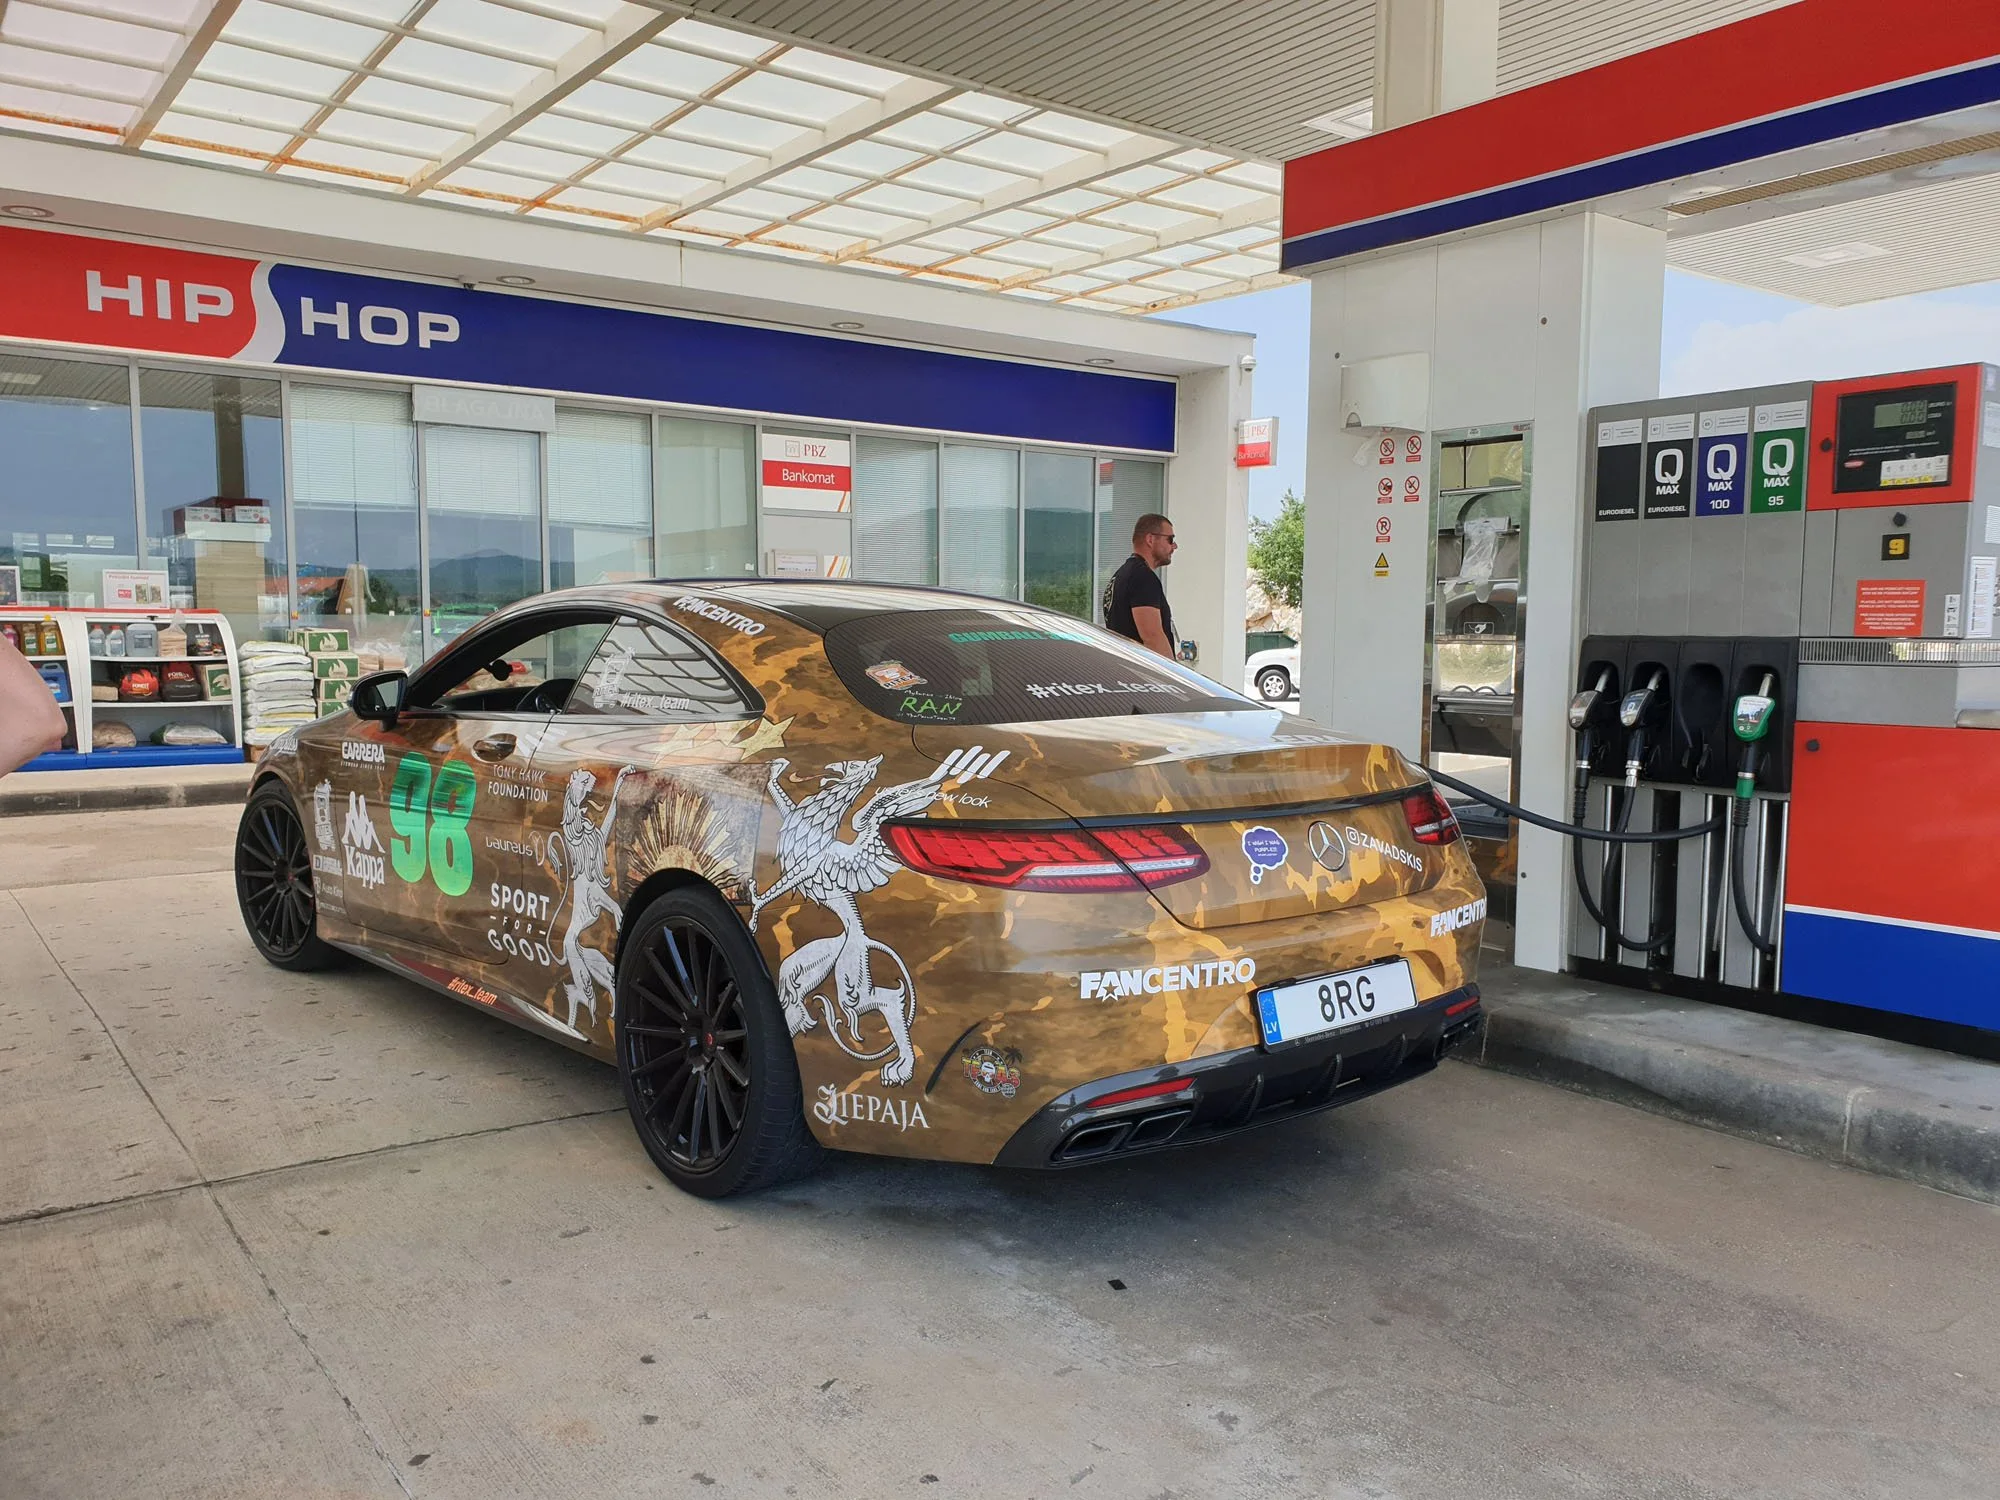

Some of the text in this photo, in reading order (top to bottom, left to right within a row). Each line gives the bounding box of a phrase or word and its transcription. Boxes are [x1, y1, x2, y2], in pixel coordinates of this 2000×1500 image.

[86, 270, 460, 349] HIP HOP
[804, 444, 827, 458] PBZ
[1762, 438, 1794, 477] Q
[1655, 448, 1684, 484] Q
[1707, 443, 1737, 480] Q
[782, 468, 835, 485] Bankomat
[1708, 480, 1733, 492] MAX
[1763, 476, 1790, 488] MAX
[1656, 484, 1680, 495] MAX
[1647, 505, 1686, 514] EURODIESEL
[1709, 499, 1730, 510] 100
[1768, 496, 1784, 506] 95
[1599, 507, 1636, 516] EURODIESEL
[1889, 538, 1905, 555] 9
[673, 595, 766, 636] FANCENTRO
[1026, 680, 1187, 699] #ritex_team
[620, 692, 690, 710] #ritex_team
[900, 696, 962, 715] RAN
[342, 742, 385, 763] CARRERA
[493, 764, 546, 784] TONY HAWK
[488, 781, 549, 803] FOUNDATION
[925, 791, 959, 802] new
[959, 793, 992, 808] look
[389, 751, 477, 896] 98
[344, 845, 385, 889] Kappa
[491, 882, 549, 920] SPORT
[487, 929, 550, 966] GOOD
[1080, 957, 1255, 1002] FANCENTRO
[447, 977, 498, 1005] #ritex_team
[1318, 975, 1376, 1023] 8RG
[1264, 1020, 1279, 1036] LV
